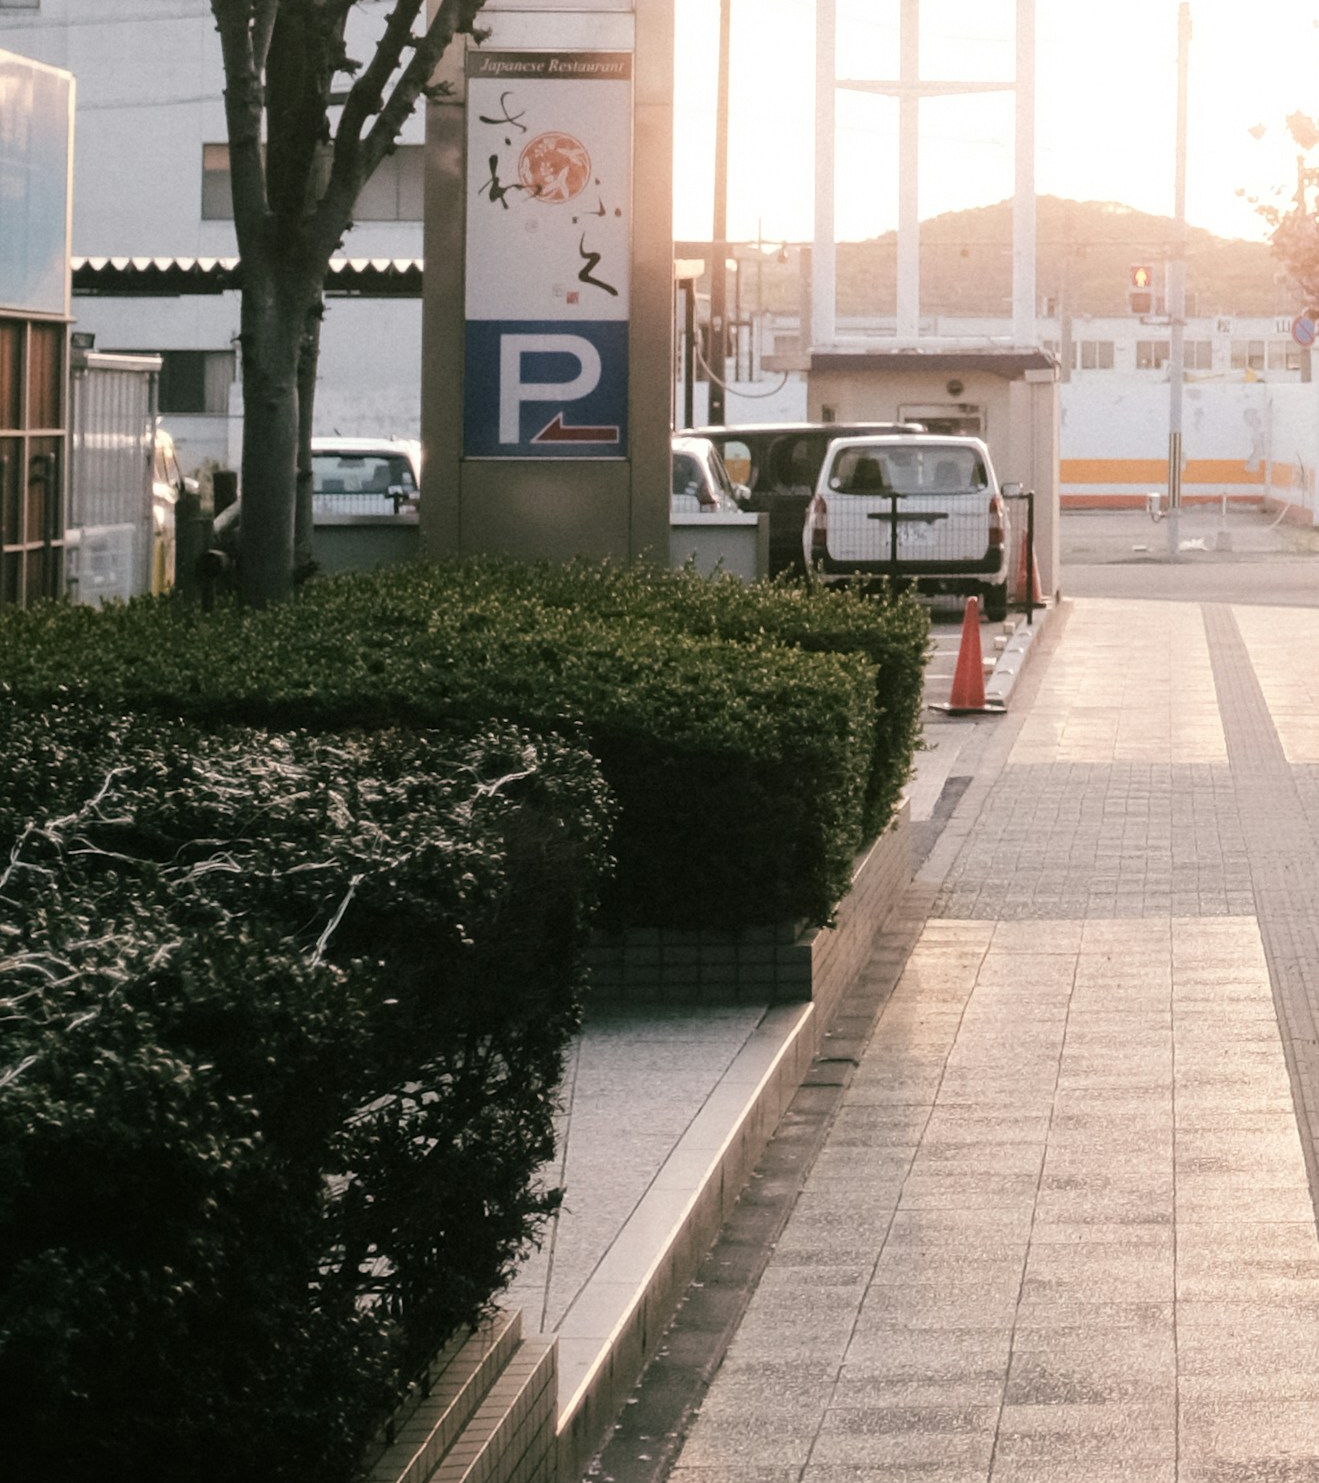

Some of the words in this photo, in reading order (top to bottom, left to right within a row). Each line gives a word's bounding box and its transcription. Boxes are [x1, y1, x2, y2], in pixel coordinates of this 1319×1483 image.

[479, 58, 545, 75] Japanese
[548, 58, 625, 73] Restaurant
[499, 334, 601, 443] P
